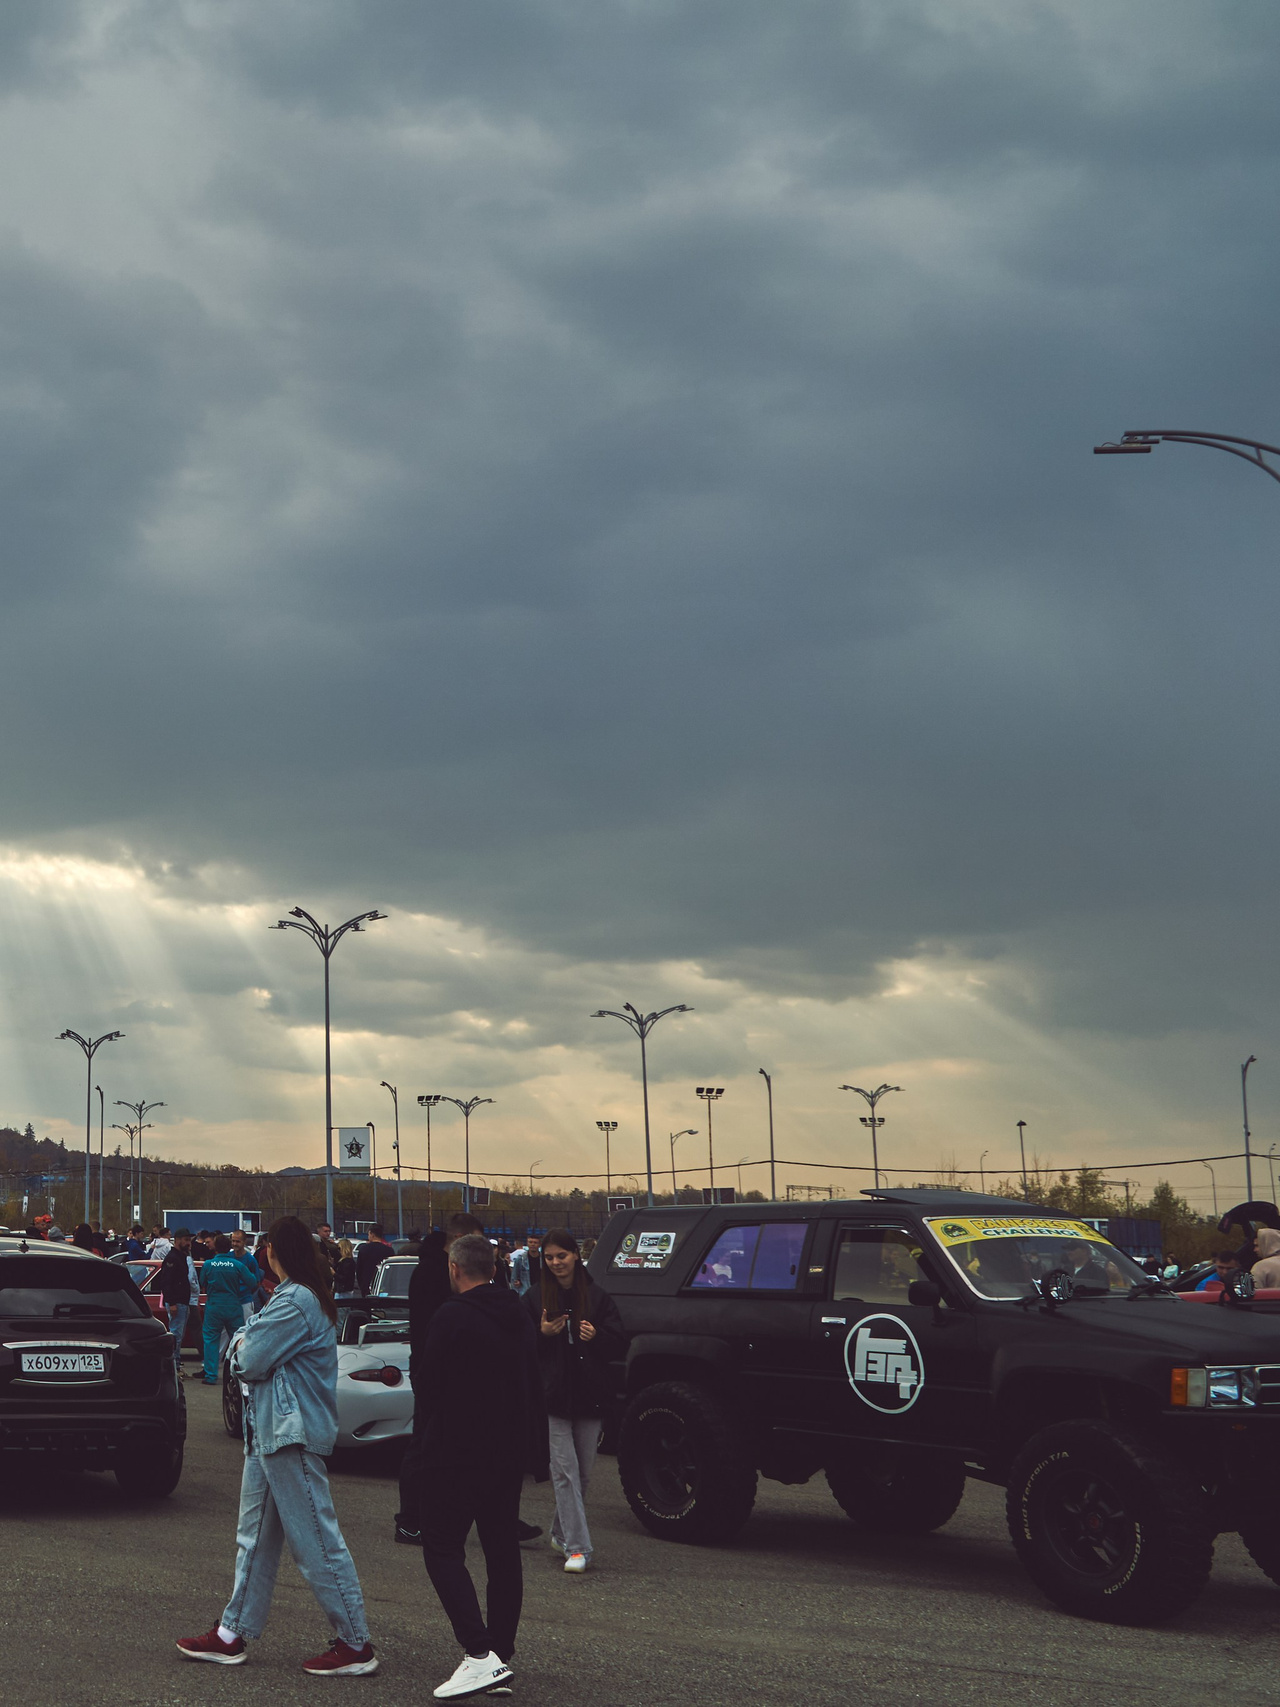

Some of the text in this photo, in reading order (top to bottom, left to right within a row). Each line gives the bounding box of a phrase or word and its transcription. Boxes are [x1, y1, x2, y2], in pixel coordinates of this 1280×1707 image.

[982, 1228, 1083, 1238] CHALLENGE
[643, 1261, 661, 1269] PIAA
[81, 1355, 100, 1366] 125
[1049, 1451, 1070, 1462] T/A
